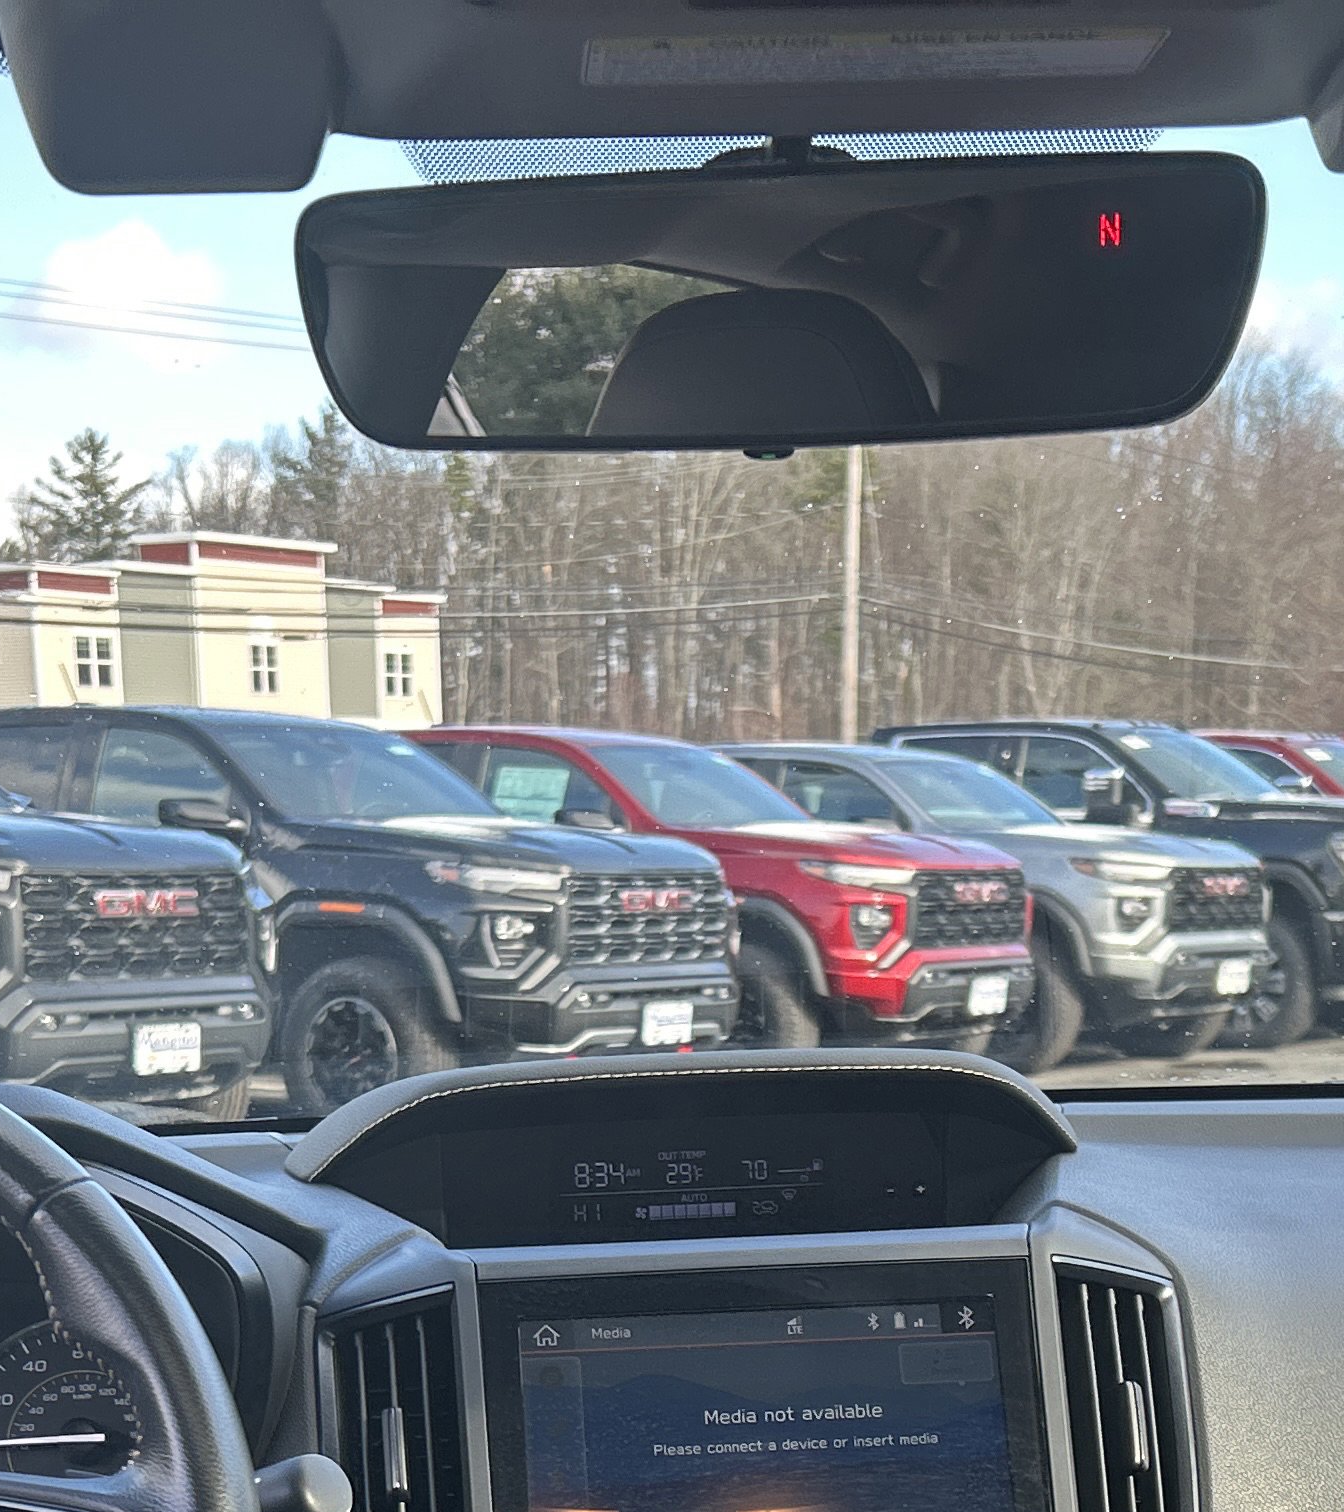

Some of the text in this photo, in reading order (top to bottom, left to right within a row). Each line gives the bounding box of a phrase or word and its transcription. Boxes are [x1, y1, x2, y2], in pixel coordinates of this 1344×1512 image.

[1099, 212, 1121, 246] N
[94, 888, 199, 918] GMC
[658, 1150, 706, 1160] OUT TEMP
[574, 1162, 641, 1188] 8:34 AM
[741, 1160, 767, 1180] 70
[680, 1193, 708, 1202] AUTO
[591, 1327, 632, 1340] Media
[787, 1325, 804, 1335] LTE
[22, 1360, 47, 1372] 40
[79, 1383, 97, 1391] 100
[42, 1393, 58, 1402] 60
[28, 1406, 44, 1415] 40
[704, 1403, 884, 1425] Media not available
[19, 1423, 35, 1432] 20
[653, 1432, 939, 1457] Please connect a device or insert media
